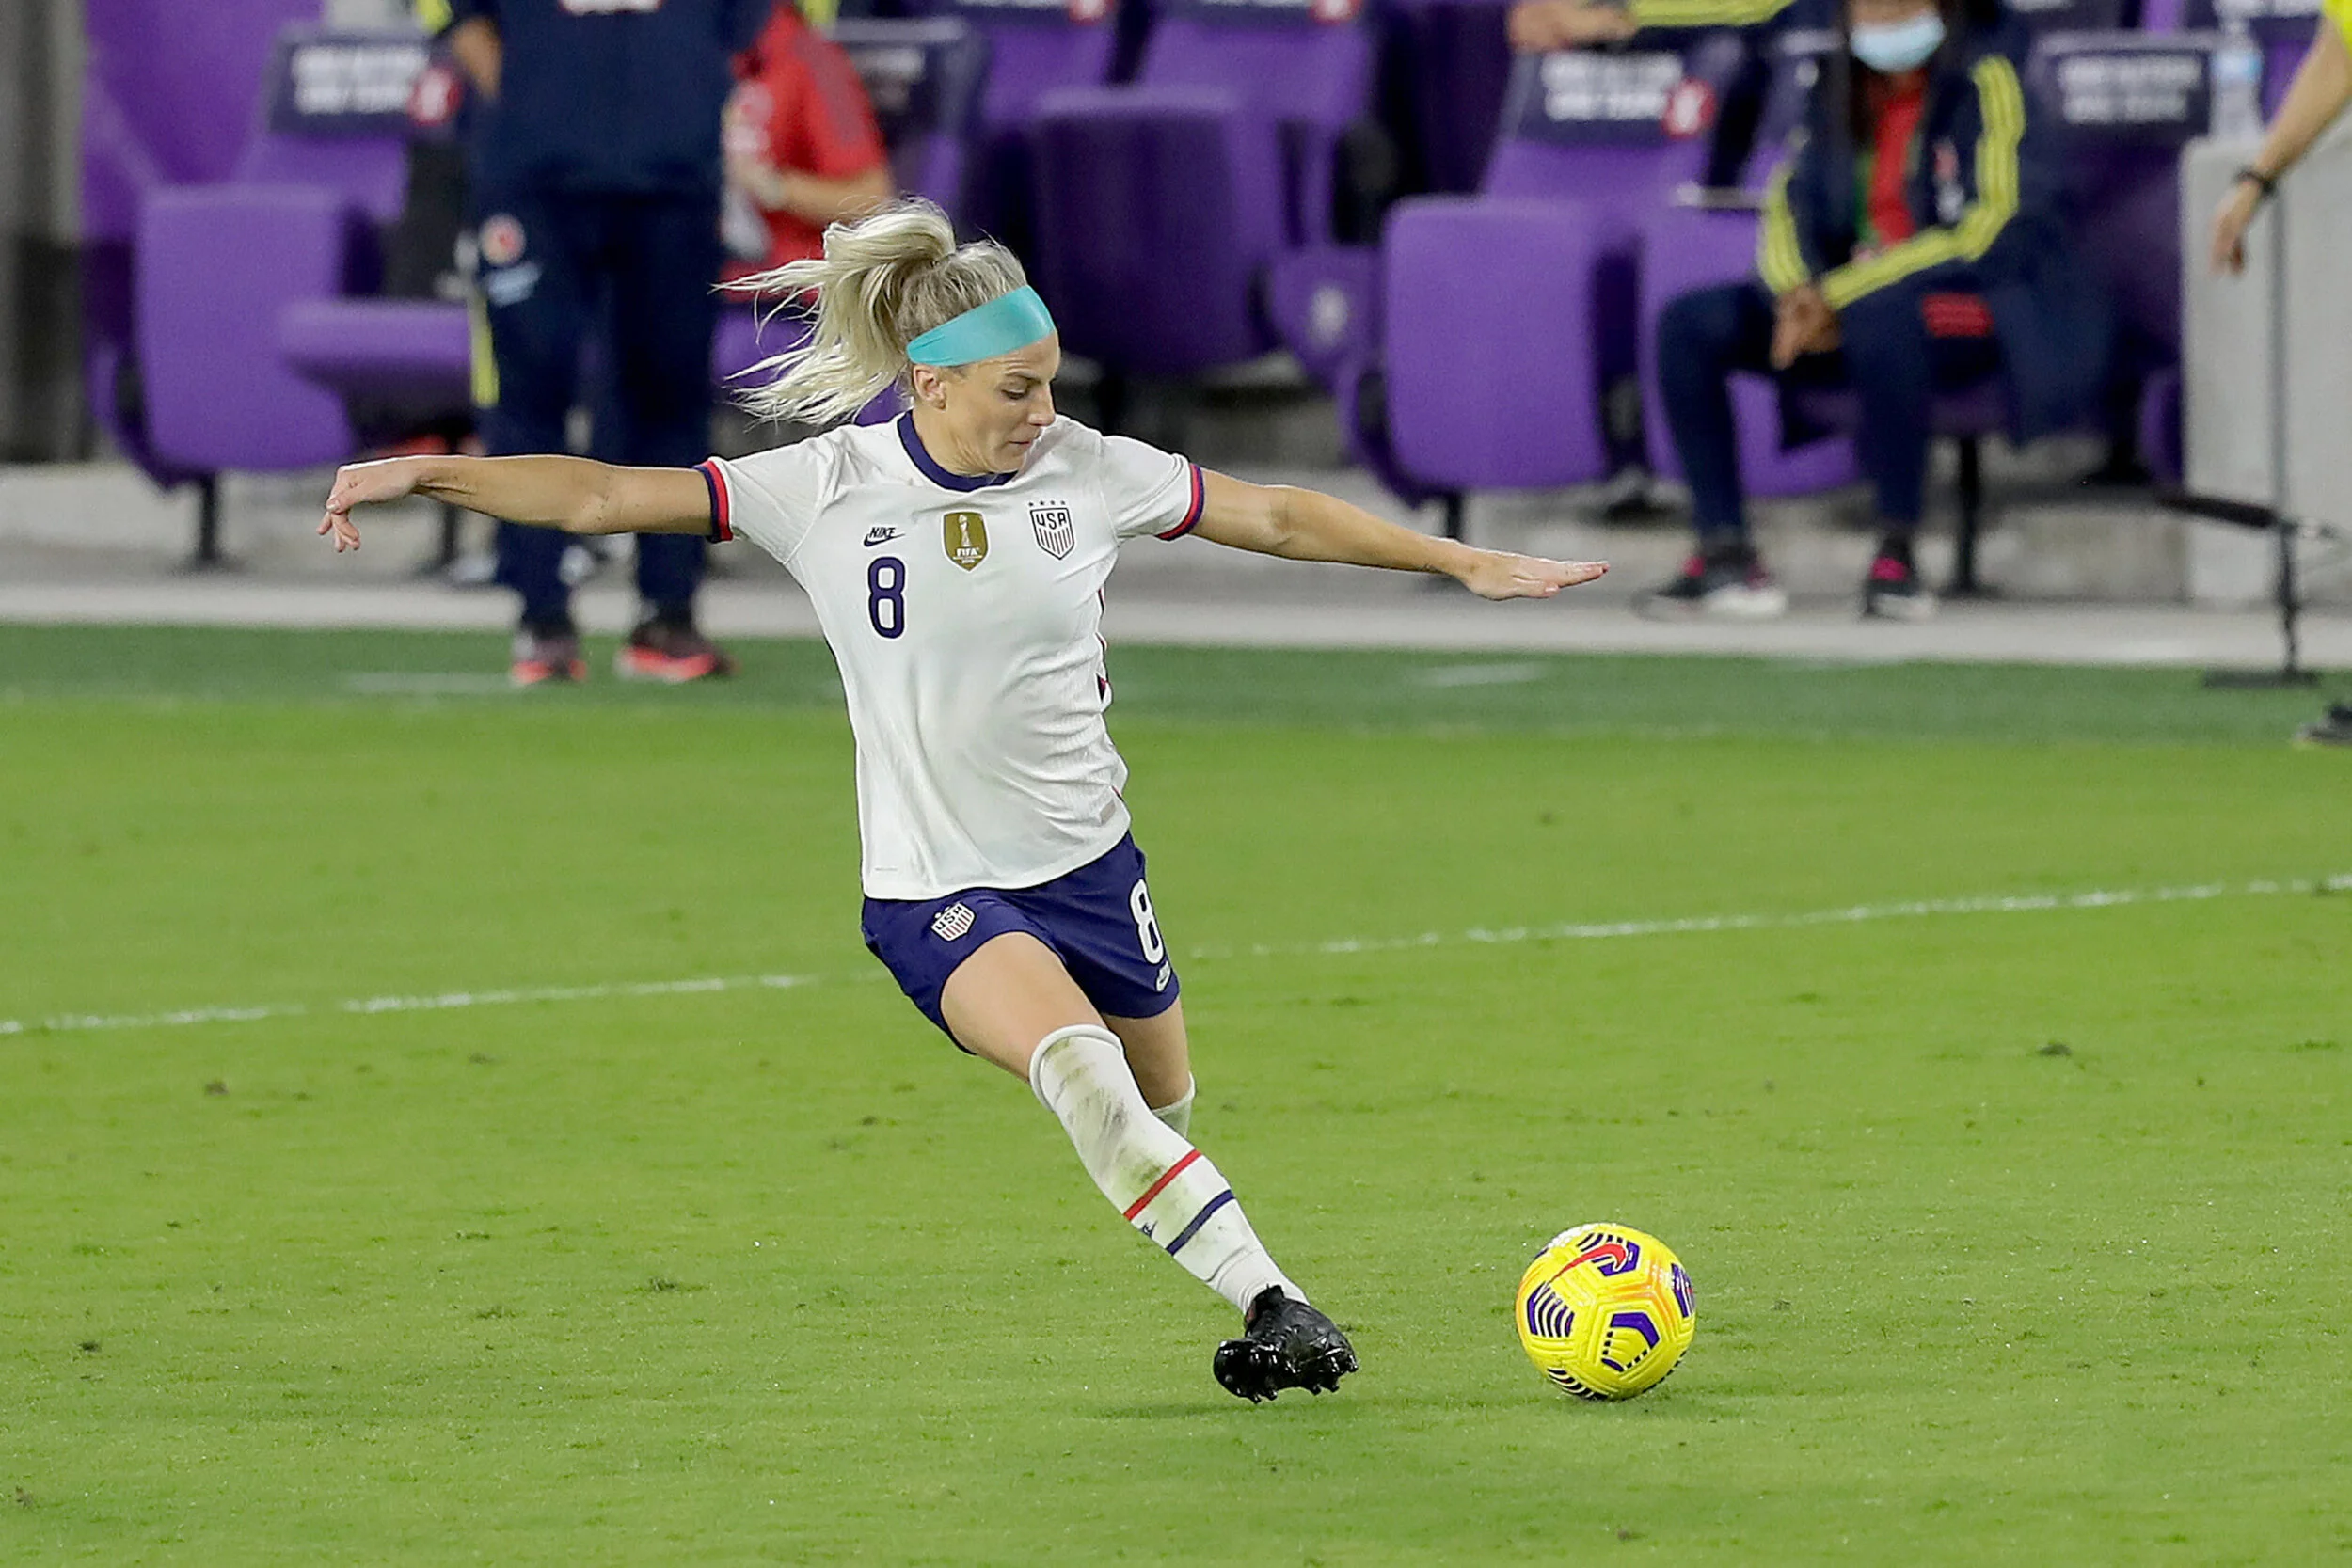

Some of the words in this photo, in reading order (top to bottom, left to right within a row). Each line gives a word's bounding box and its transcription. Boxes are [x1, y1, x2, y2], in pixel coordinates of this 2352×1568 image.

[1035, 512, 1067, 530] USA
[869, 526, 896, 538] NIKE
[956, 547, 978, 557] FIFA
[868, 557, 905, 638] 8
[935, 906, 962, 930] USA
[1130, 879, 1164, 964] 8
